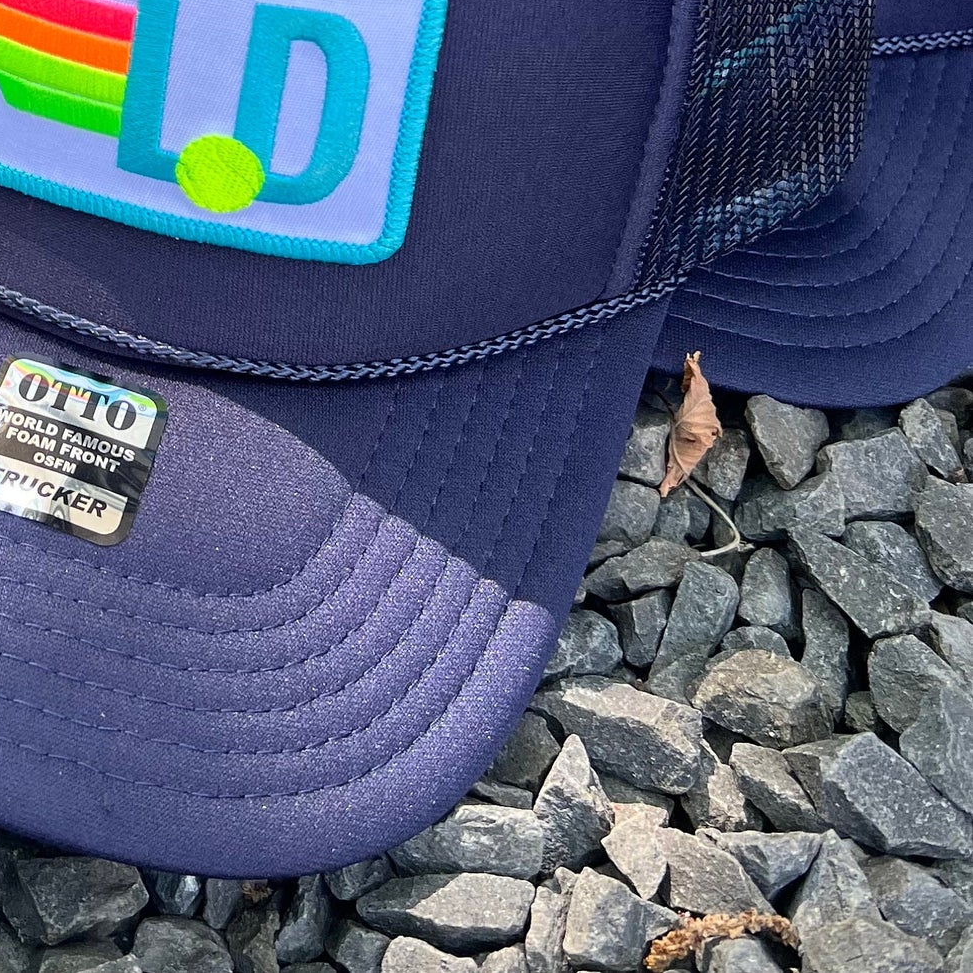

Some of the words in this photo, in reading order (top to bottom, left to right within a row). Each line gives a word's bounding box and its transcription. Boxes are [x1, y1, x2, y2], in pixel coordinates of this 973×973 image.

[18, 372, 137, 431] OTTO
[5, 426, 57, 452] FOAM
[59, 442, 121, 473] FRONT
[33, 452, 77, 475] OSFM
[61, 428, 136, 462] FAMOUS
